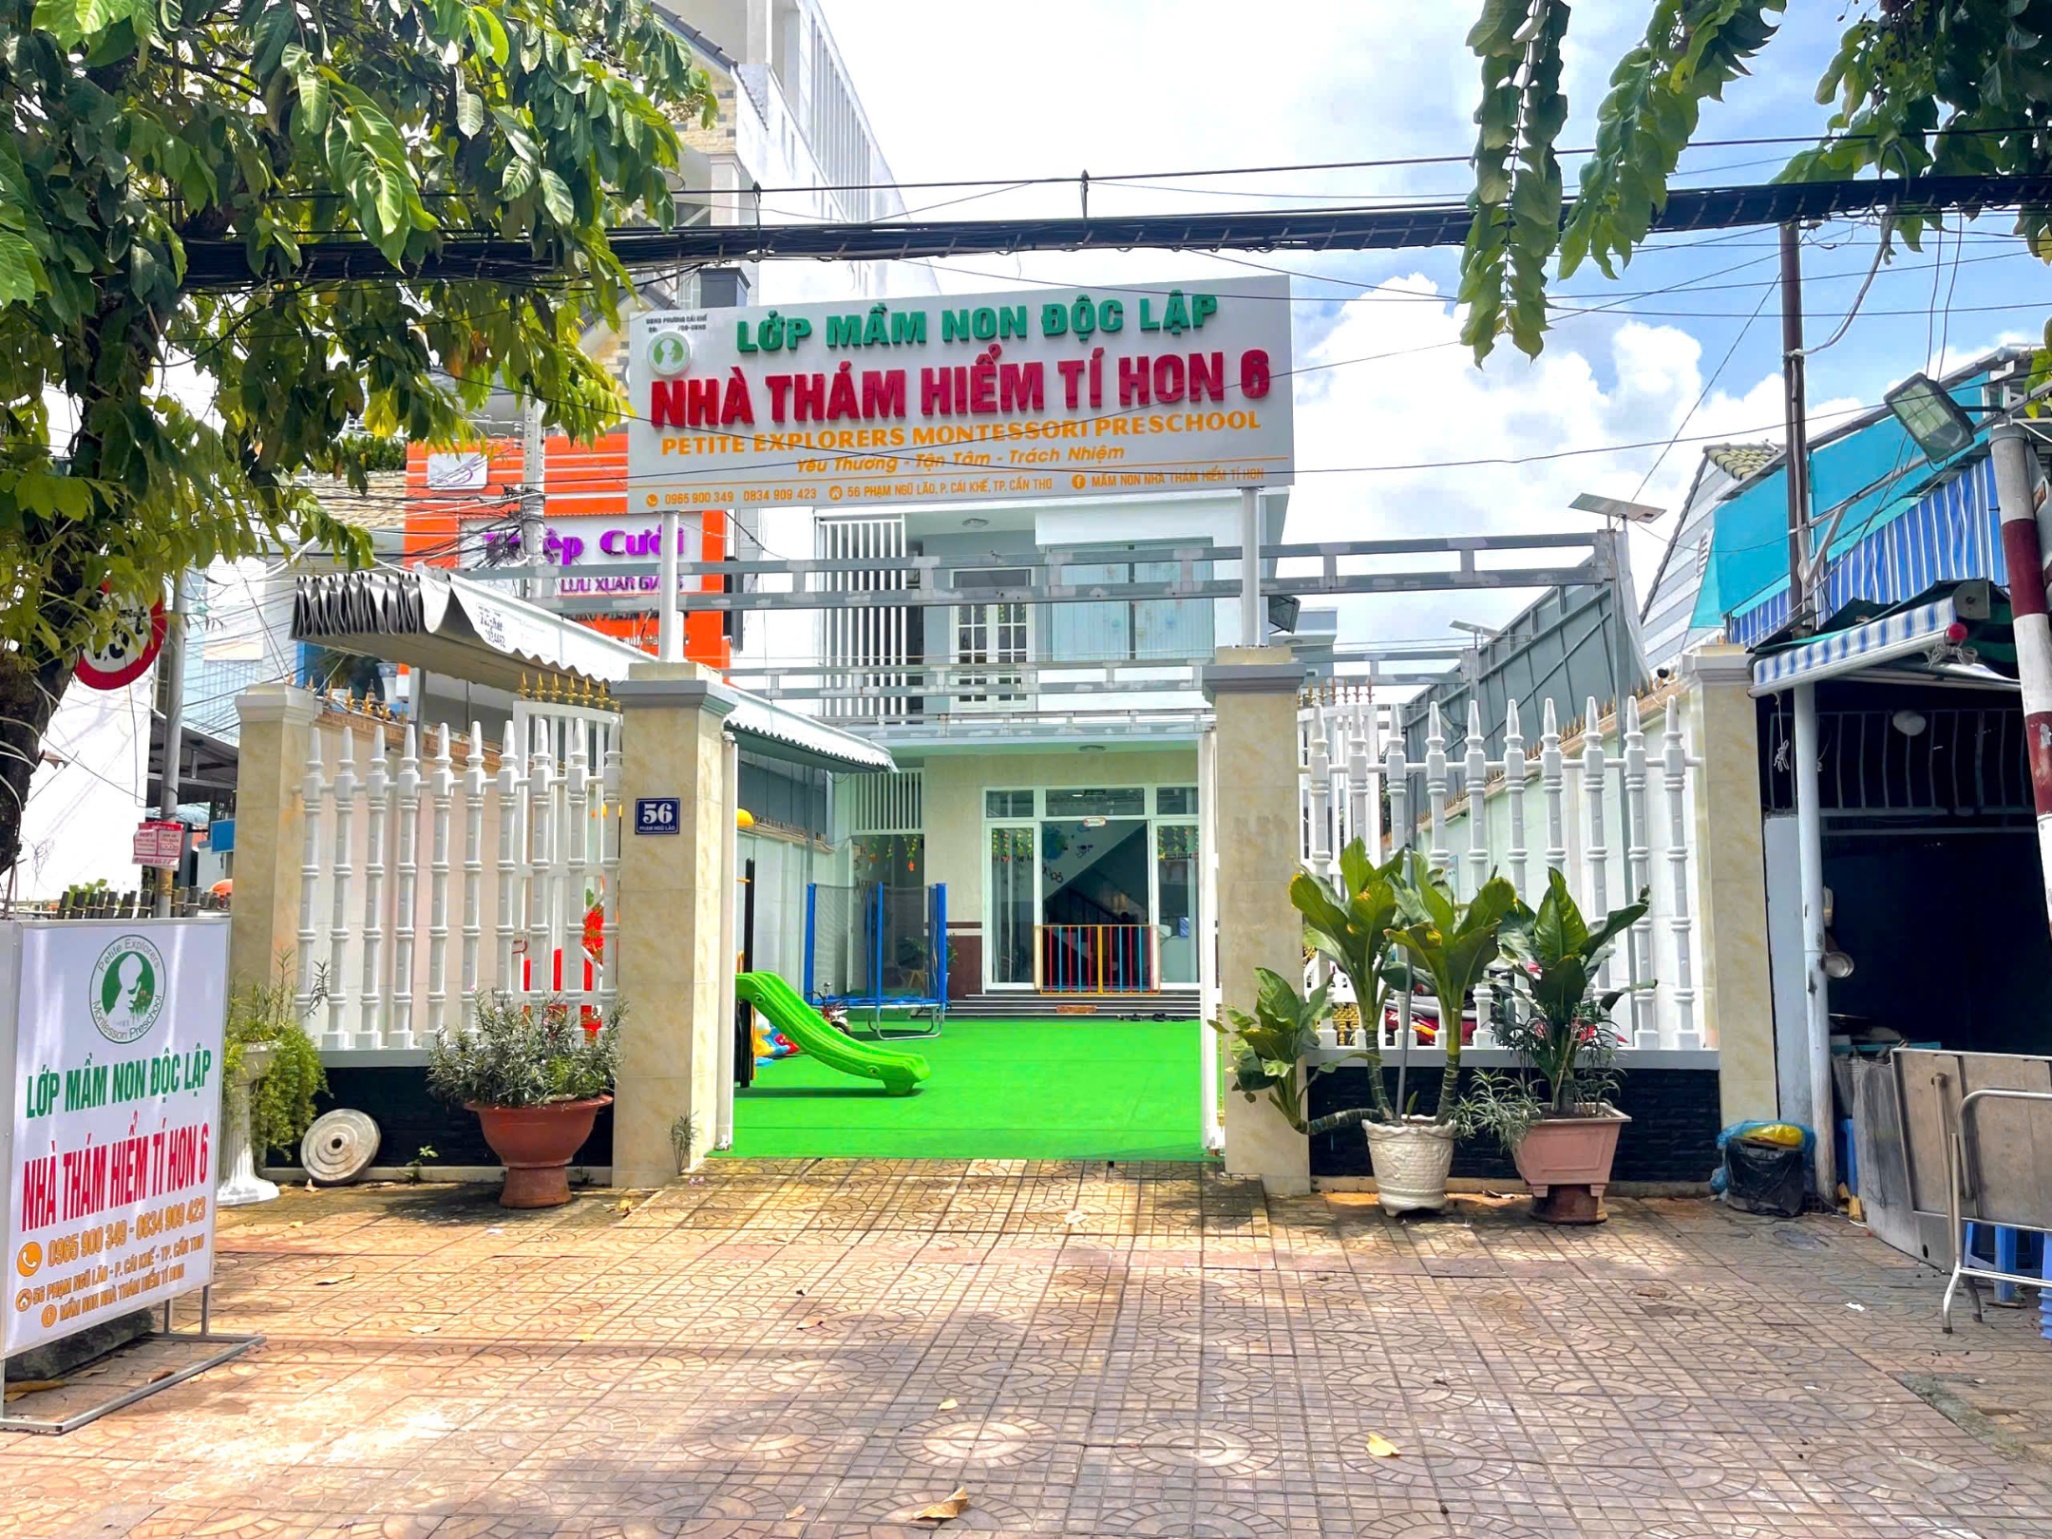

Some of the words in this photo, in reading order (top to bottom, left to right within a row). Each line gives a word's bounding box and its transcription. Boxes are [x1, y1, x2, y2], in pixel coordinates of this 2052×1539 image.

[738, 310, 812, 352] LỚP
[827, 302, 927, 347] MẦM
[942, 305, 1027, 343] NON
[1041, 294, 1123, 341] ĐỘC
[1139, 289, 1217, 335] LẬP
[652, 366, 755, 428] NHÀ
[765, 361, 906, 423] THÁM
[921, 343, 1044, 416] HIỂM
[1057, 347, 1104, 409] TÍ
[1119, 351, 1224, 406] HON
[1240, 349, 1270, 400] 6
[662, 435, 745, 456] PETITE
[753, 427, 905, 453] EXPLORERS
[913, 419, 1087, 446] MONTESSORI
[1095, 410, 1261, 436] PRESCHOOL
[797, 456, 827, 473] Yêu
[834, 456, 898, 473] Thương
[915, 452, 945, 471] Tận
[953, 451, 990, 466] Tâm
[1009, 448, 1060, 464] Trách
[1068, 445, 1125, 463] Nhiệm
[1120, 474, 1140, 486] NON
[1144, 471, 1165, 485] NHÀ
[1243, 468, 1264, 480] HON
[665, 493, 689, 504] 0965
[692, 492, 710, 504] 900
[713, 491, 734, 503] 349
[744, 489, 770, 501] 0834
[774, 489, 793, 500] 909
[797, 488, 817, 500] 423
[847, 486, 860, 497] 56
[864, 484, 891, 498] PHẠM
[895, 482, 913, 495] NGŨ
[951, 480, 966, 493] CÁI
[642, 803, 673, 824] 56
[98, 944, 122, 972] Petite
[124, 939, 160, 969] Explorers
[93, 1000, 128, 1040] Montessori
[129, 995, 162, 1039] Preschool
[26, 1064, 60, 1118] LỚP
[64, 1052, 108, 1112] MẦM
[112, 1059, 147, 1103] NON
[150, 1047, 180, 1103] ĐỘC
[184, 1042, 211, 1097] LẬP
[21, 1140, 57, 1232] NHÀ
[63, 1133, 107, 1221] THÁM
[109, 1110, 149, 1208] HIỂM
[152, 1117, 167, 1197] TÍ
[167, 1124, 198, 1193] HON
[199, 1122, 209, 1184] 6
[47, 1233, 79, 1268] 0965
[80, 1225, 104, 1258] 900
[105, 1219, 128, 1250] 349
[135, 1210, 163, 1240] 0834
[164, 1202, 185, 1230] 909
[186, 1196, 206, 1224] 423
[32, 1285, 45, 1305] 56
[47, 1276, 72, 1301] PHẠM
[74, 1269, 90, 1291] NGŨ
[92, 1264, 108, 1285] LÃO
[124, 1254, 137, 1275] CÁI
